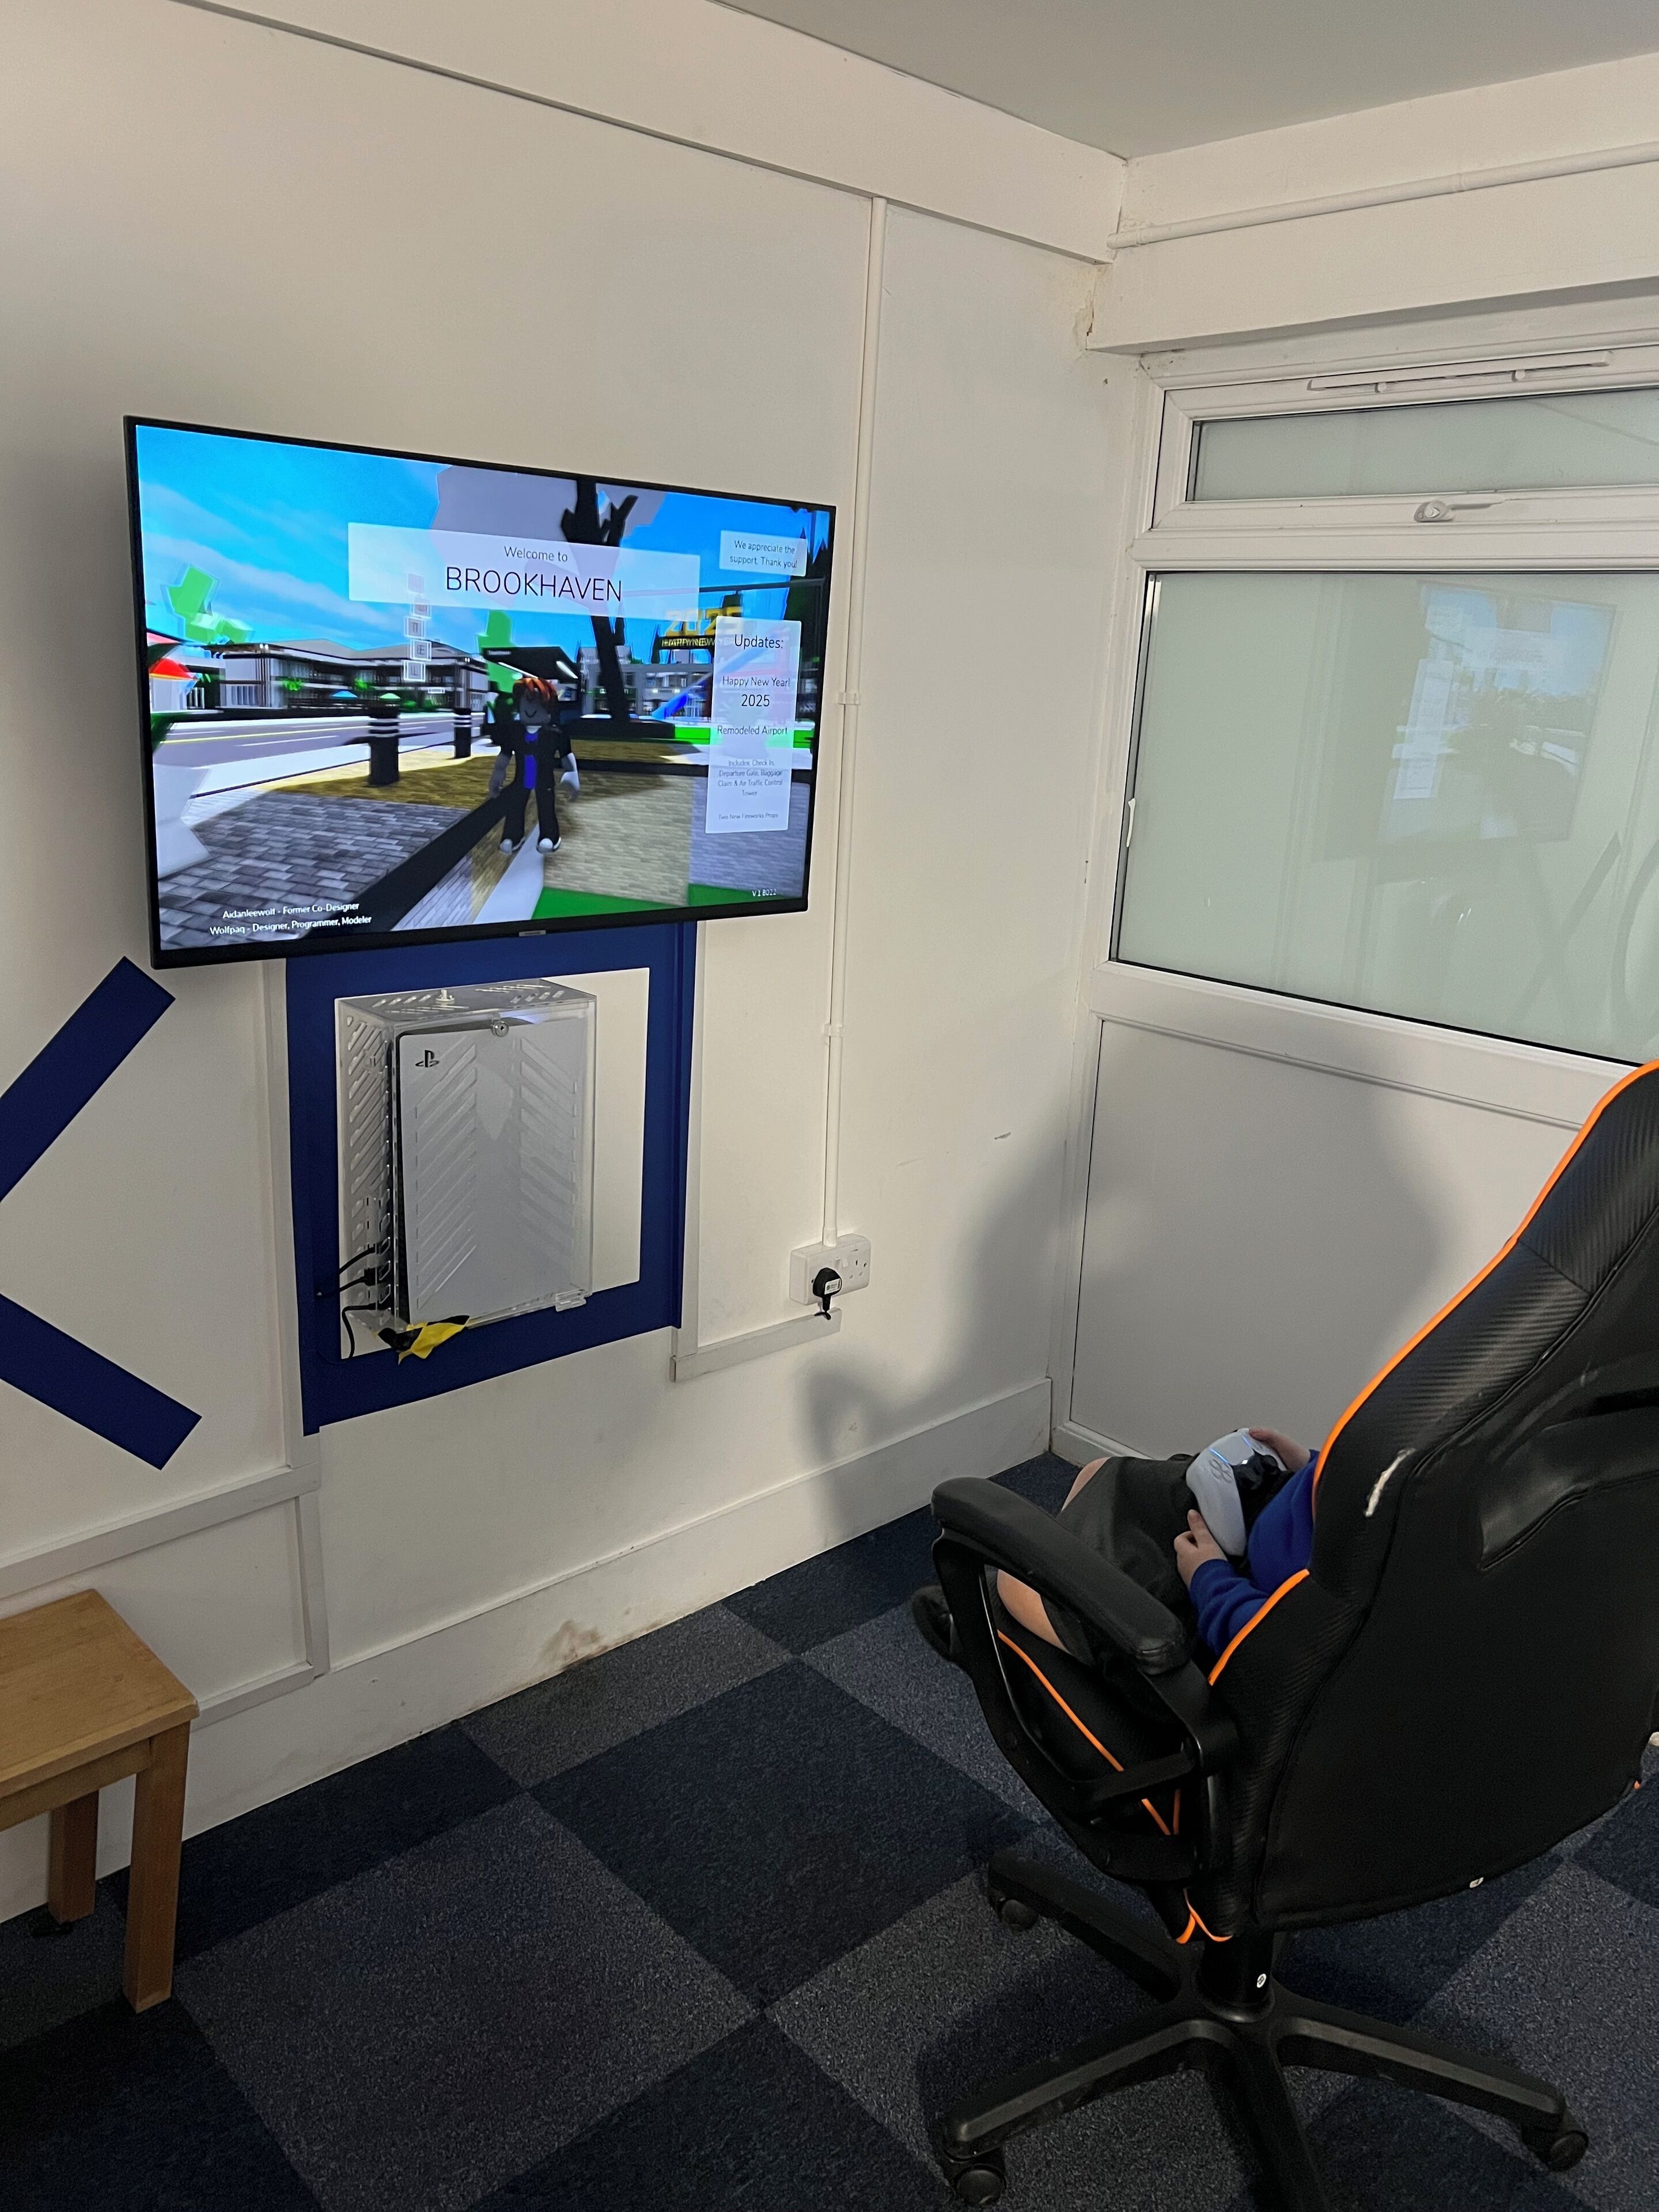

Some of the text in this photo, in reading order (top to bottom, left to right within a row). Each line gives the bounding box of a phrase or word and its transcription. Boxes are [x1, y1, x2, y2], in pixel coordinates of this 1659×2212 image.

[734, 540, 795, 554] We appreciate the
[504, 546, 568, 562] Welcome to
[760, 556, 782, 567] Thank
[446, 566, 622, 602] BROOKHAVEN
[734, 634, 783, 650] Updates:
[722, 676, 749, 688] Happy
[751, 677, 769, 686] New
[741, 694, 770, 707] 2025
[717, 725, 787, 736] Remodeled Airport
[283, 906, 310, 915] Former
[312, 903, 359, 912] Co-Designer
[342, 915, 372, 925] Modeler
